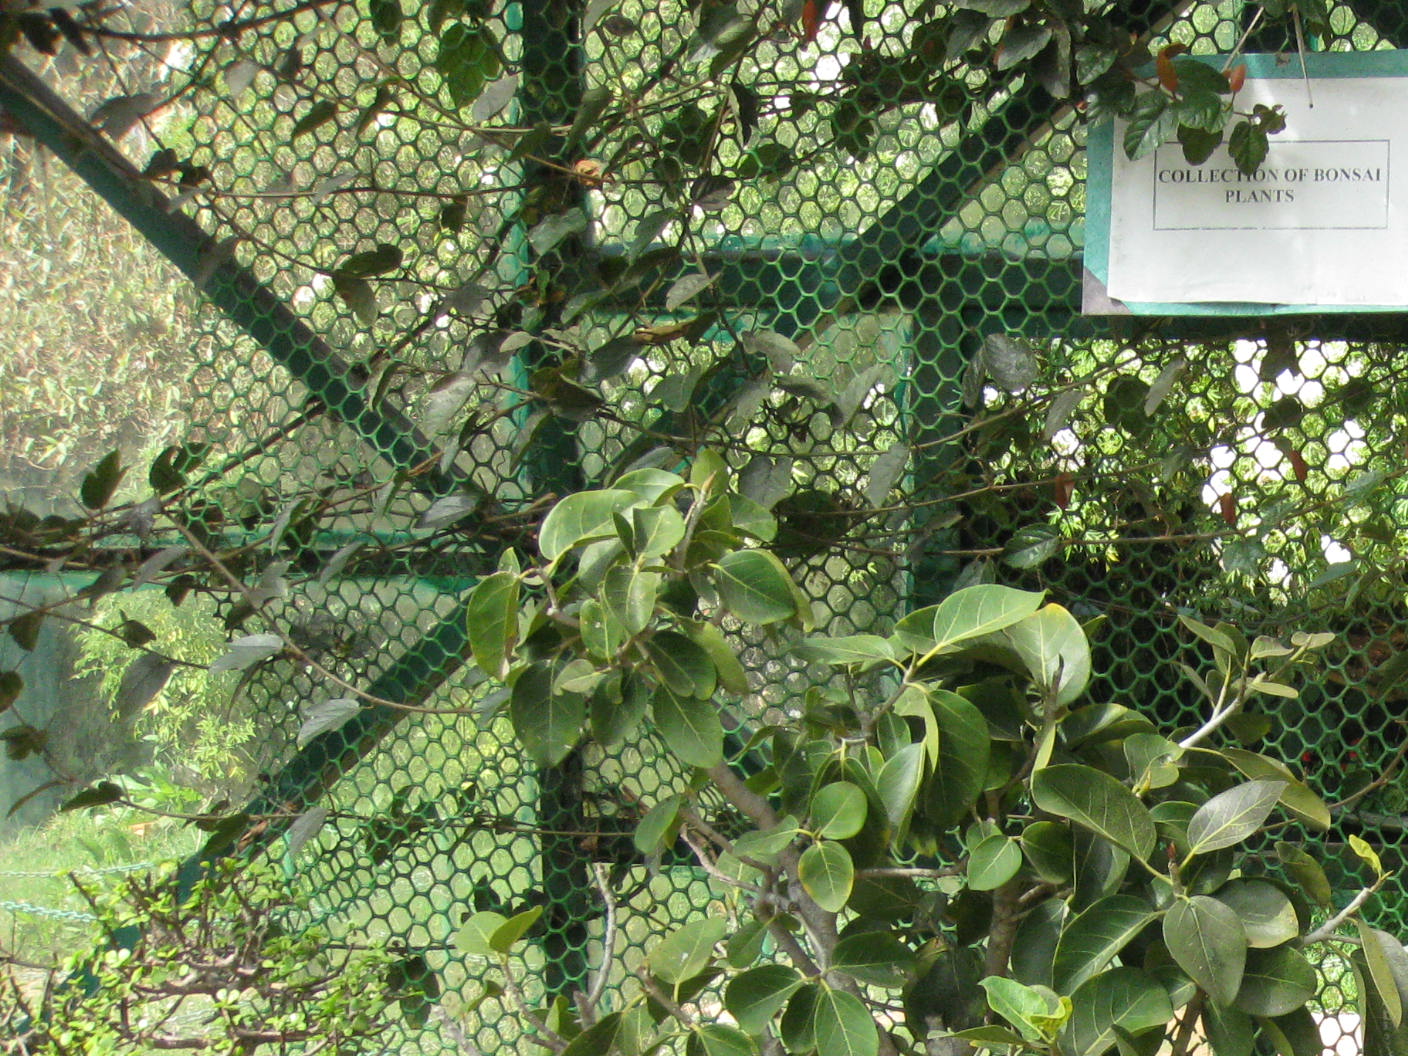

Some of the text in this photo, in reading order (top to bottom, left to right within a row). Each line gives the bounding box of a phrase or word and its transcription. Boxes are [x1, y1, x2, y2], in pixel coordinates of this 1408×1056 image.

[1284, 168, 1309, 182] OF
[1314, 168, 1381, 182] BONSAI
[1225, 189, 1295, 203] PLANTS
